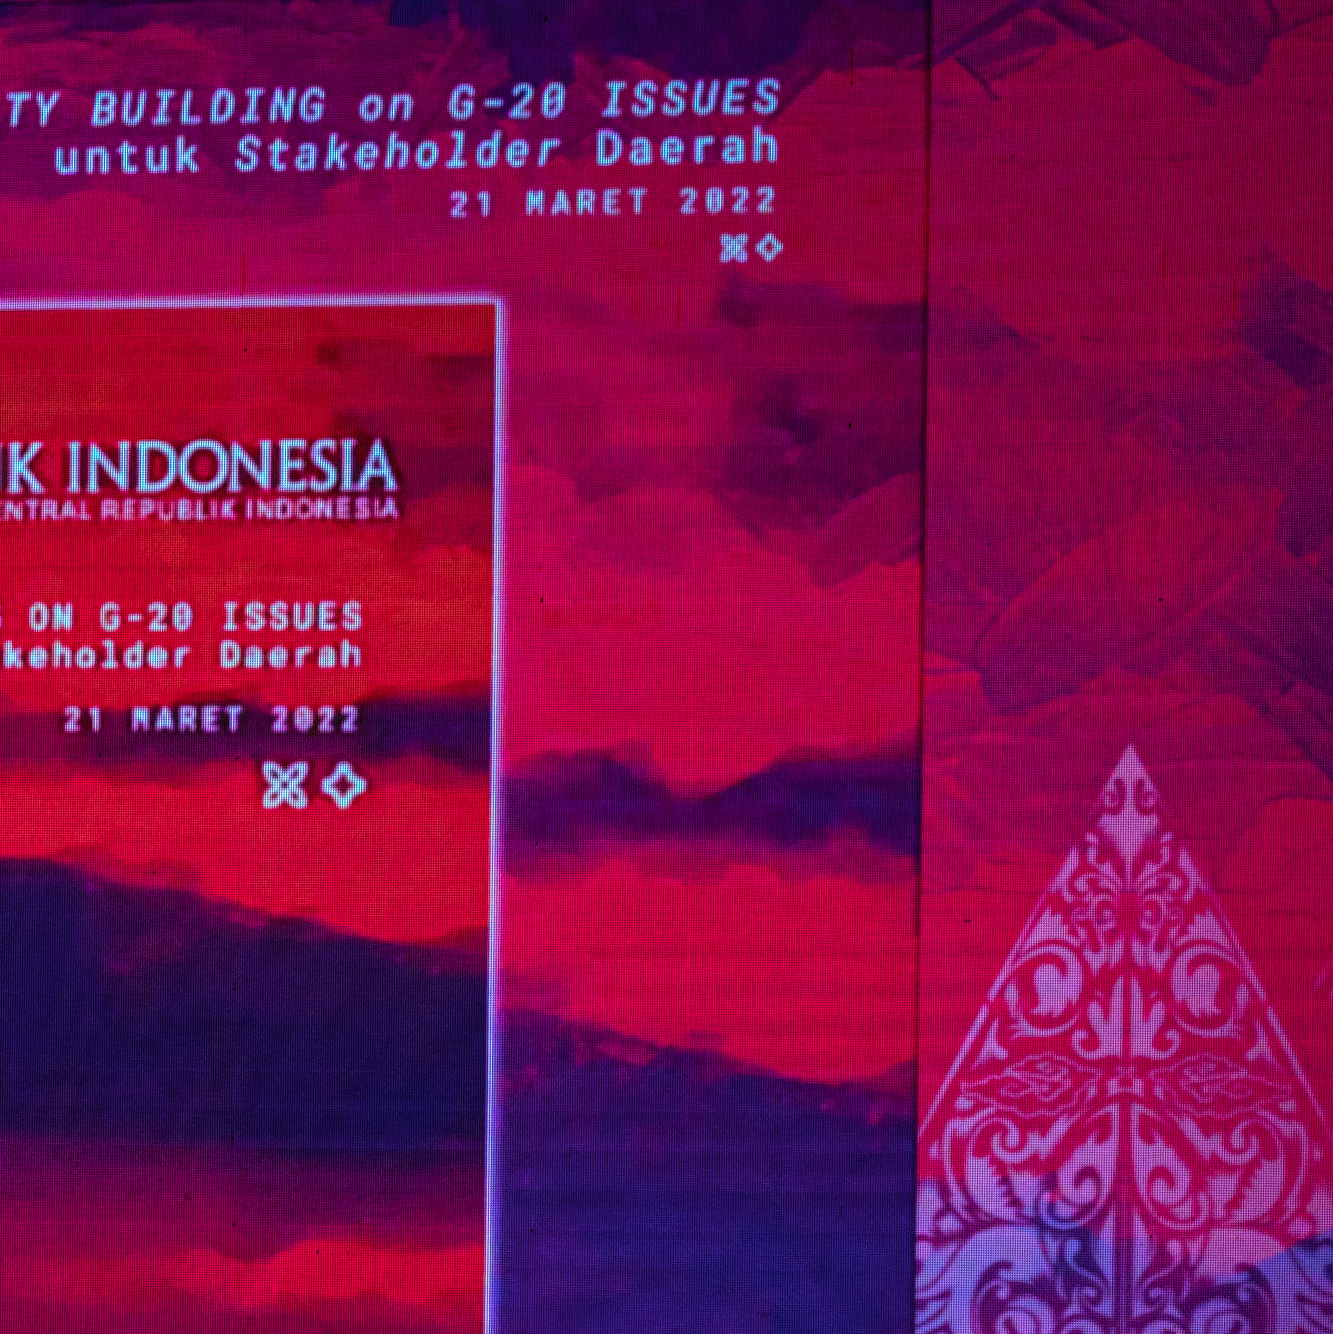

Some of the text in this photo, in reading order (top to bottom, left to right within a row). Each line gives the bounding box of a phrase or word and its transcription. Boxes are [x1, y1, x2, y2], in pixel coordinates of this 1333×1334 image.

[91, 86, 325, 127] BUILDING
[359, 94, 413, 122] on
[448, 82, 566, 120] G-20
[603, 78, 779, 117] ISSUES
[55, 126, 777, 175] untuk Stakeholder Daerah
[451, 186, 775, 218] 21 MARET 2022
[69, 439, 396, 493] INDONESIA
[101, 498, 233, 521] REPUBLIK
[246, 497, 397, 519] INDONESIA
[29, 602, 72, 631] ON
[100, 602, 192, 632] G-20
[224, 600, 362, 631] ISSUES
[220, 640, 360, 669] Daerah
[65, 705, 357, 732] 21 MARET 2022
